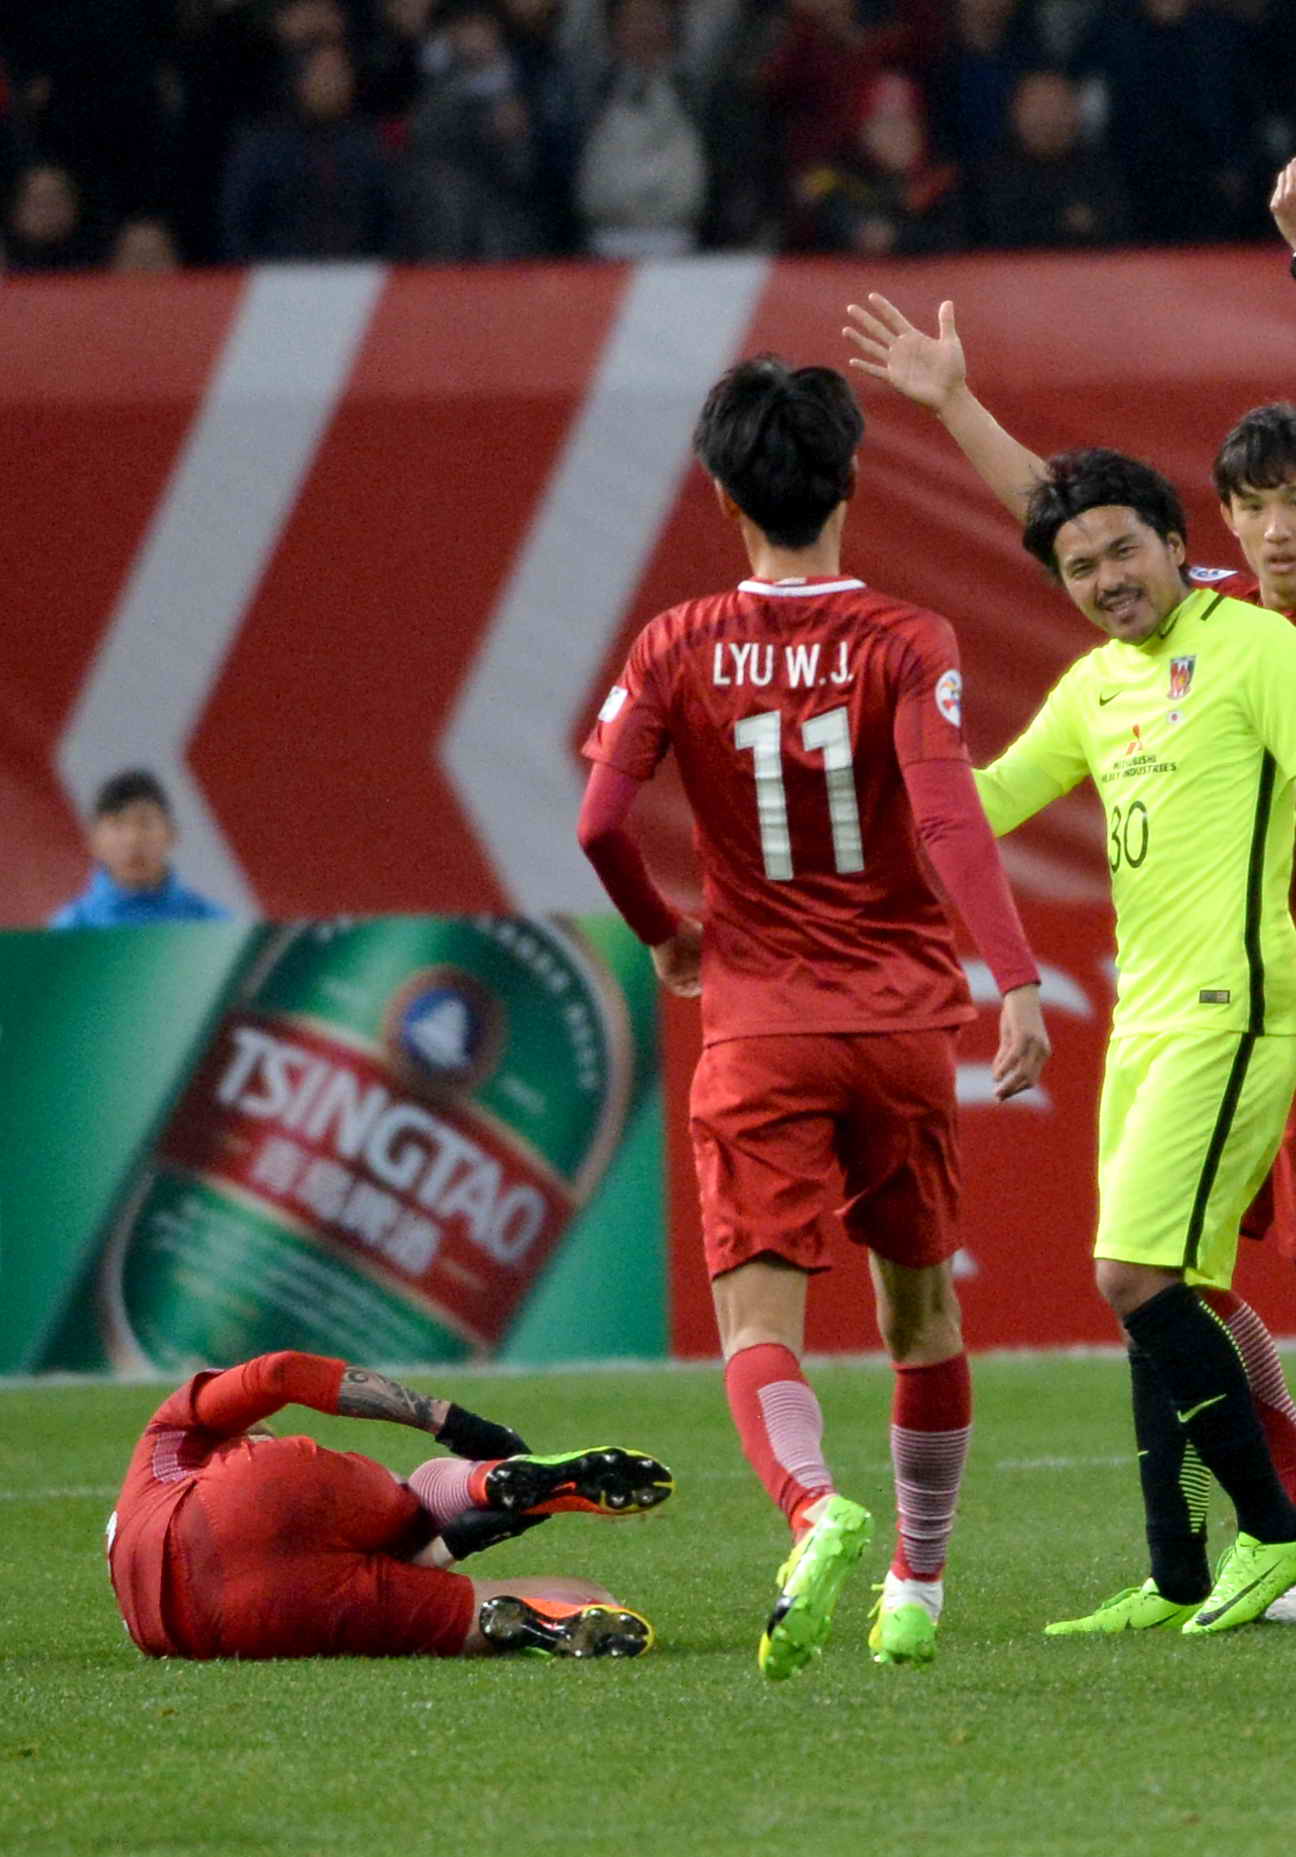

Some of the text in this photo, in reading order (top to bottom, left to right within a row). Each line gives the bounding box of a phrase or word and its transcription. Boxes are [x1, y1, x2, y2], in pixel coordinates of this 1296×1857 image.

[713, 642, 773, 686] LYU
[733, 705, 865, 882] 11
[216, 1025, 549, 1266] TSINGTAO
